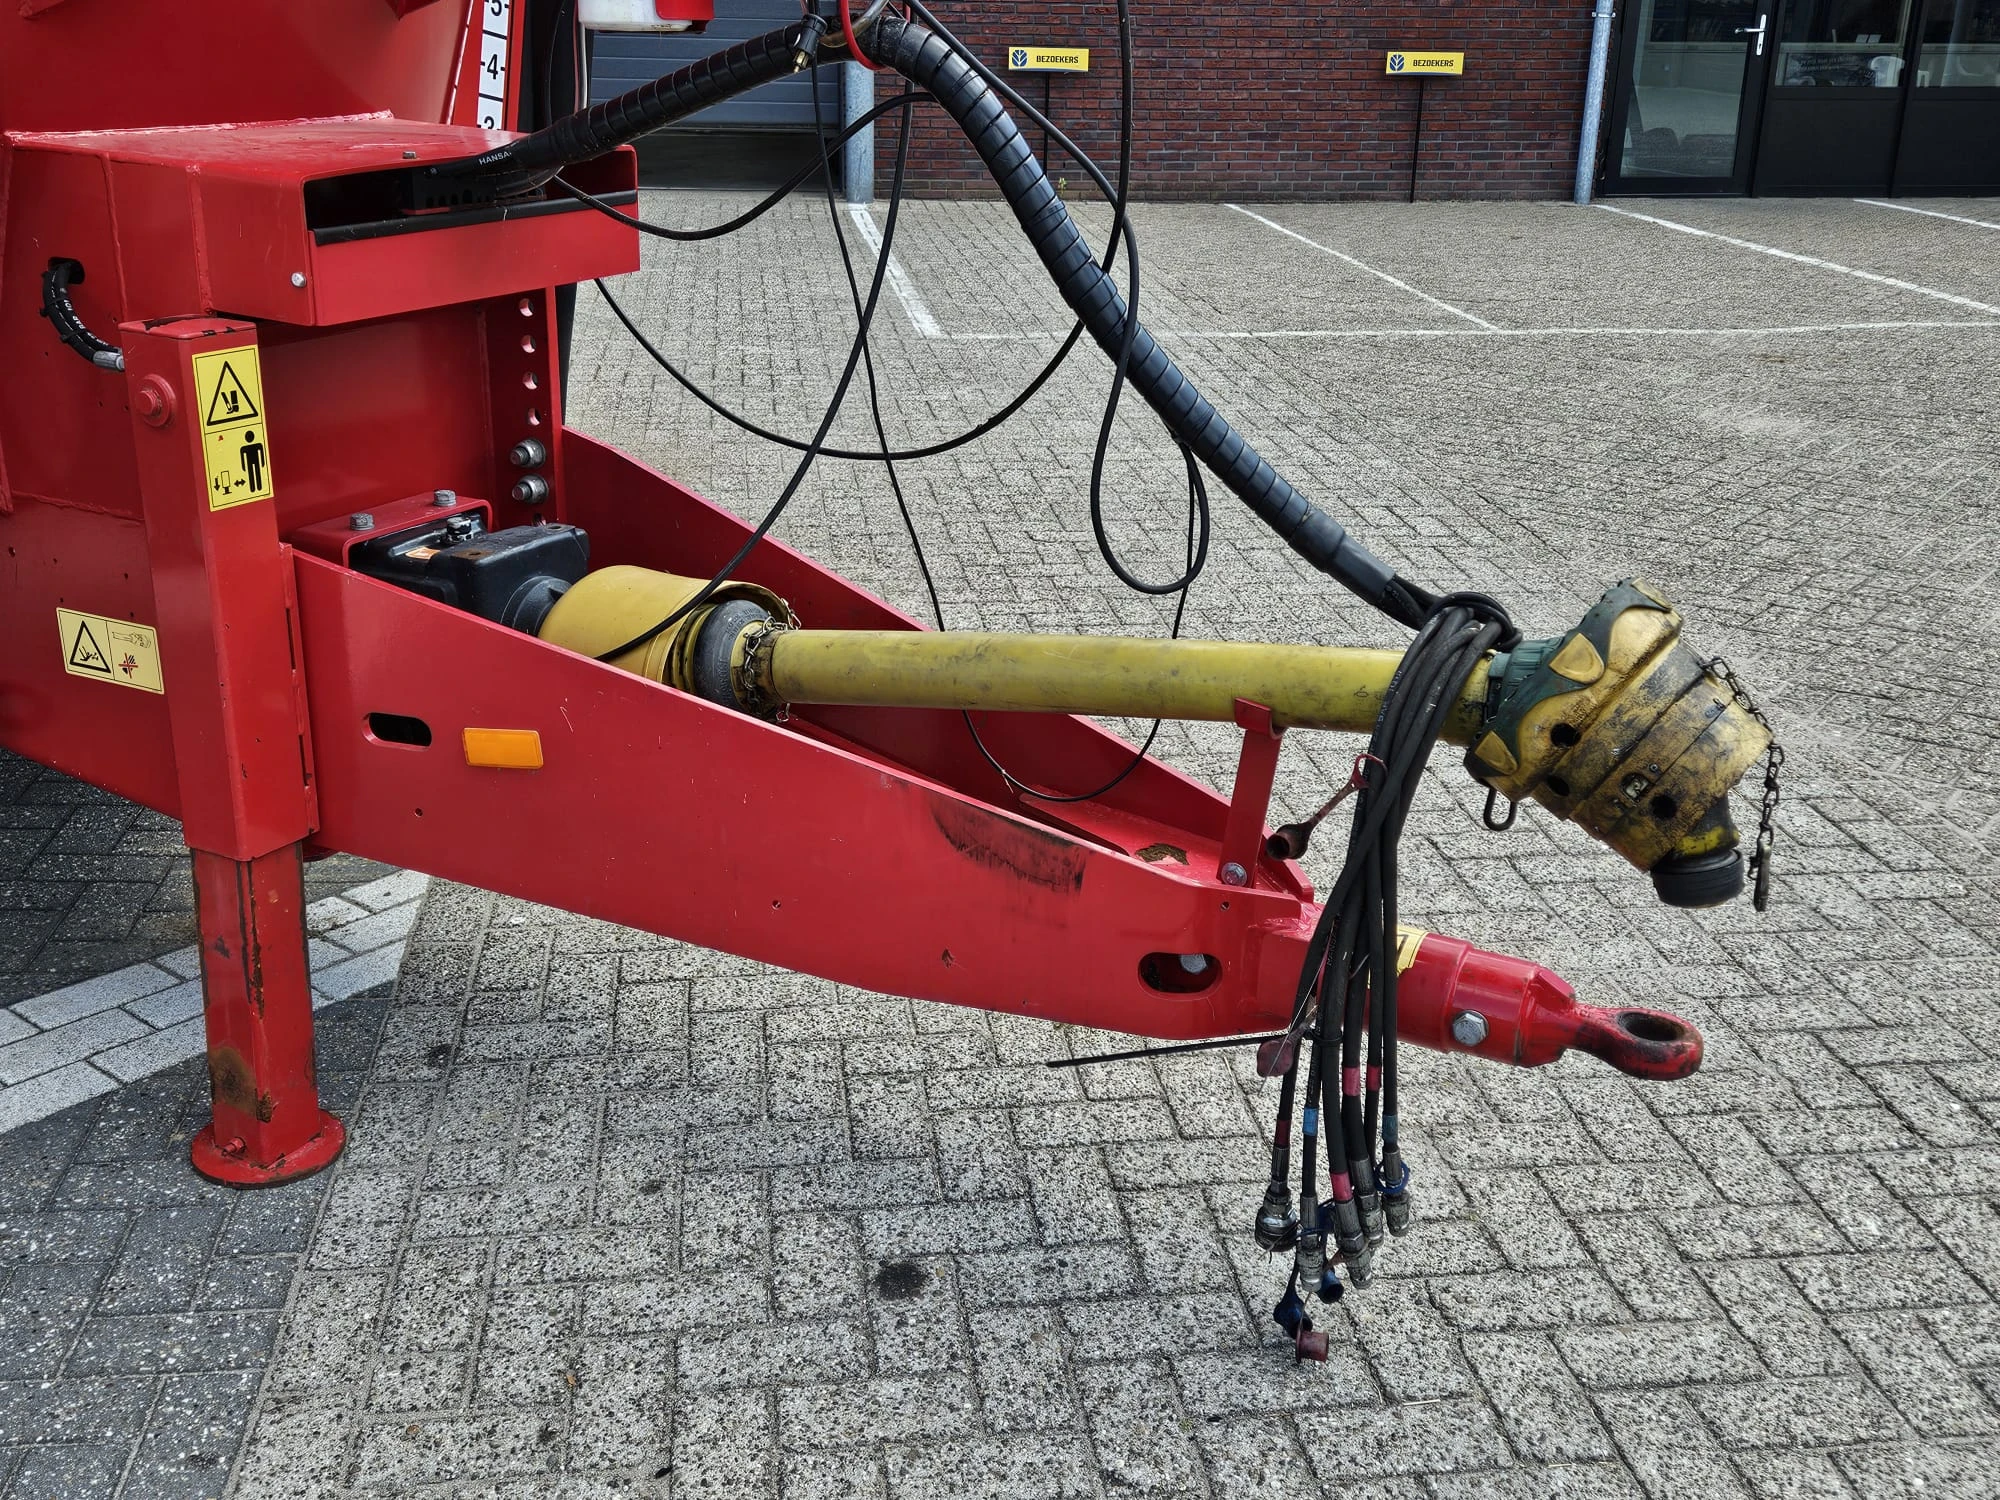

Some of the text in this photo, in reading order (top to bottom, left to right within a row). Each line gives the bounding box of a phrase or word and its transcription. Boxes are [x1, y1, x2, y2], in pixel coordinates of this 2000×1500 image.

[1036, 55, 1079, 64] BEZOEKERS
[1413, 59, 1454, 67] BEZOEKERS
[486, 53, 499, 80] 4
